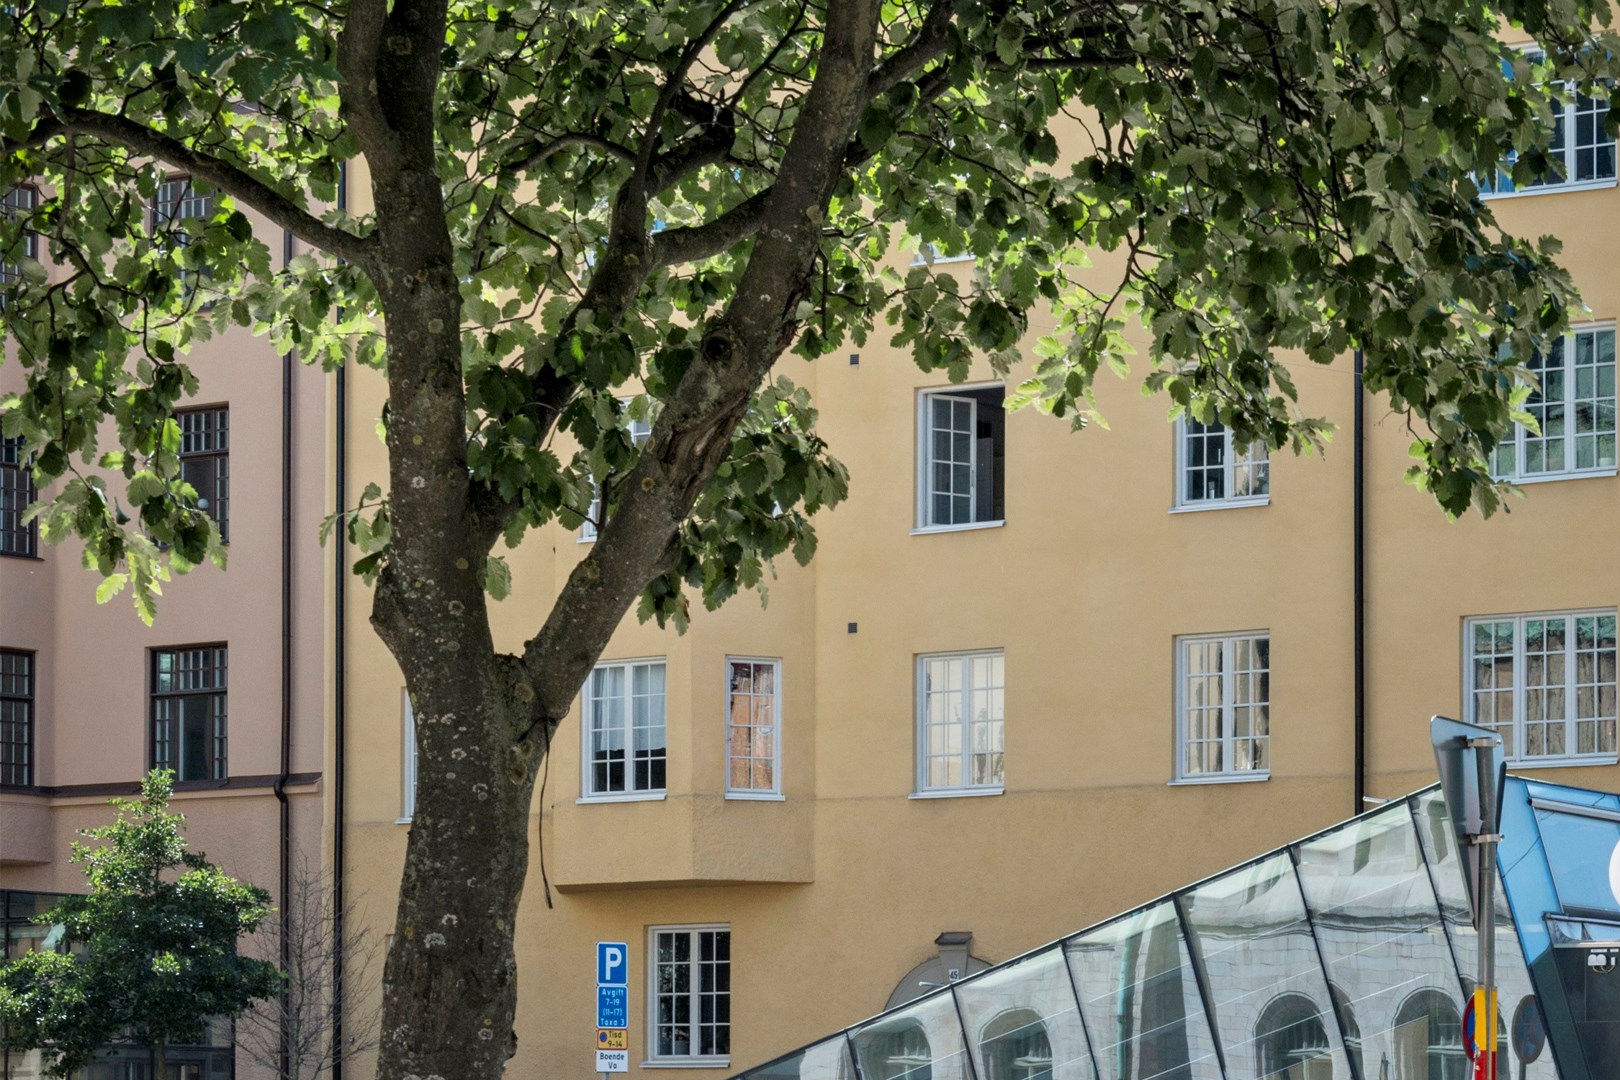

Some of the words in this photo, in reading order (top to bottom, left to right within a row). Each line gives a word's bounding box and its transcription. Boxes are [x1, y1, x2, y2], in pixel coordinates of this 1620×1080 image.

[605, 947, 622, 981] P
[602, 988, 624, 998] Avgift
[602, 1008, 622, 1016] (11-17)
[601, 1018, 618, 1026] Taxa
[620, 1018, 626, 1026] 3
[608, 1030, 622, 1039] Tisd
[599, 1052, 625, 1060] Boende
